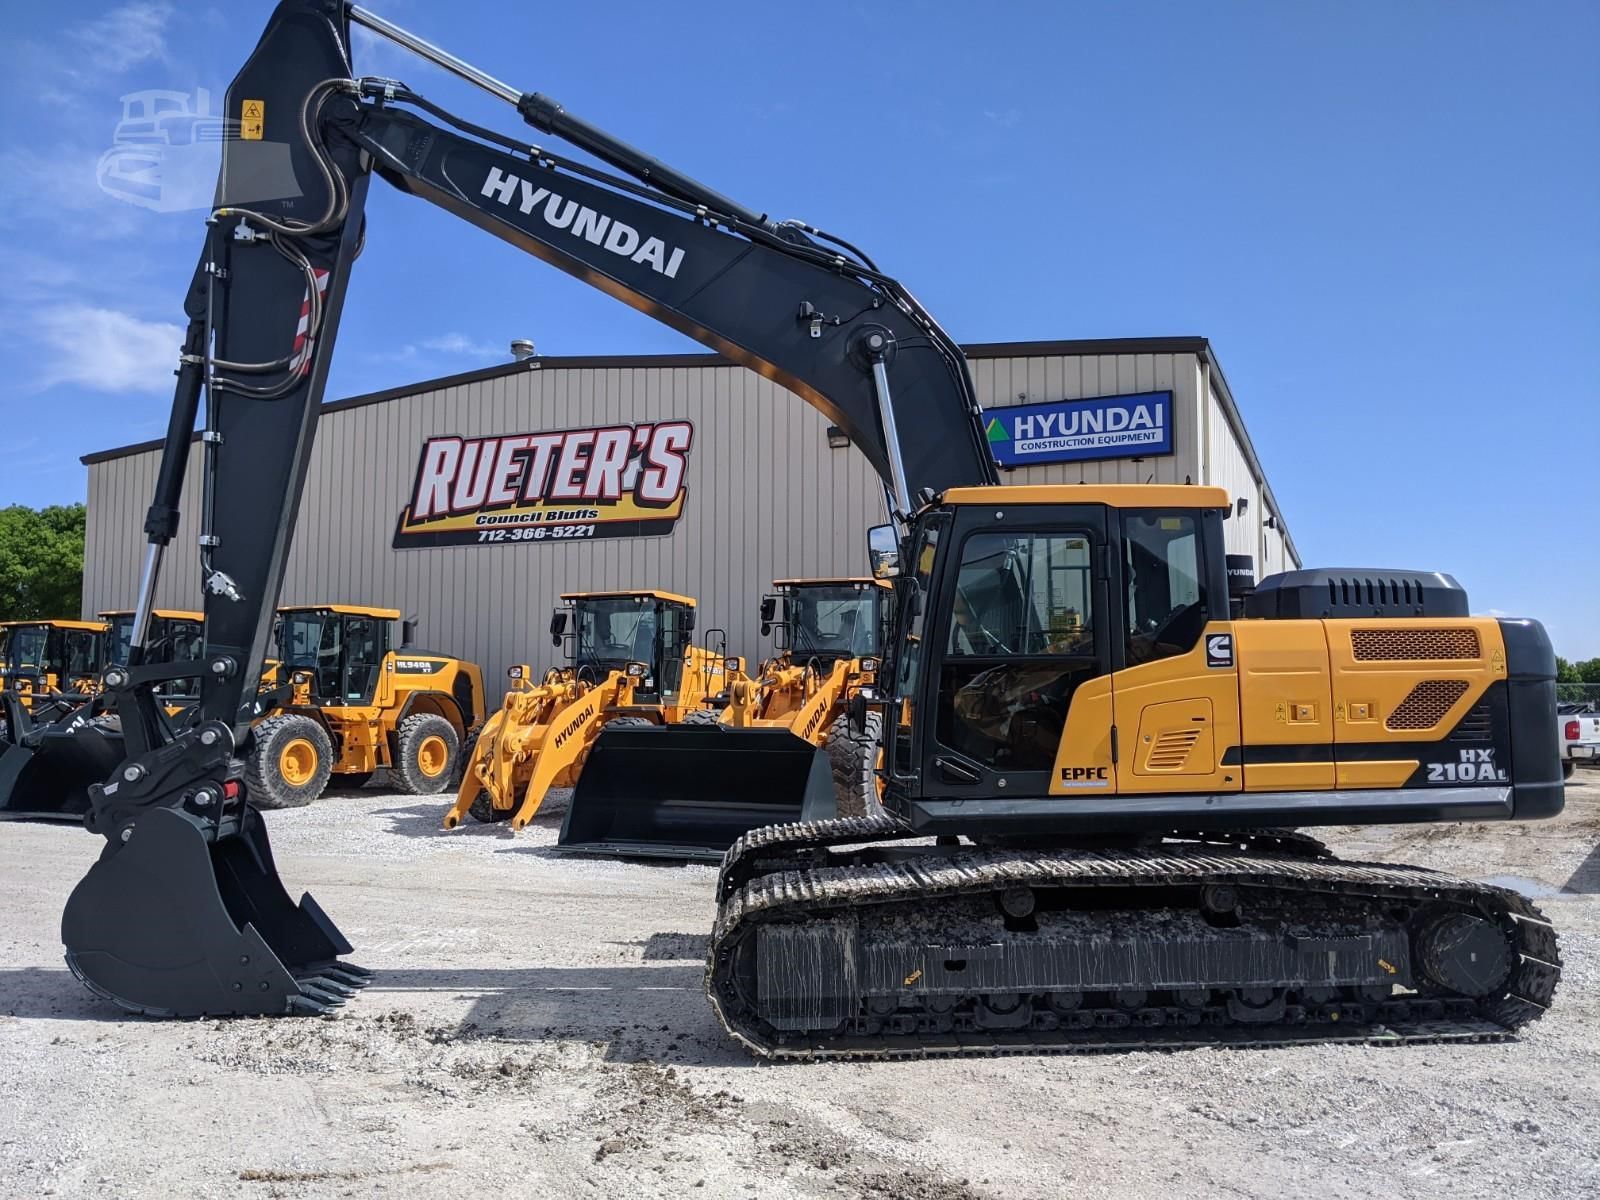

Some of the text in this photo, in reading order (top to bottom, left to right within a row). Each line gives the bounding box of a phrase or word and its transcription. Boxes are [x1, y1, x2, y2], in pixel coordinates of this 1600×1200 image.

[480, 166, 685, 279] HYUNDAI
[1014, 403, 1163, 440] HYUNDAI
[1021, 432, 1156, 451] CONSTRUCTION EQUIPMENT
[413, 422, 693, 519] RUETER'S
[475, 508, 598, 526] Council Bluffs
[477, 524, 596, 542] 712-366-5221
[554, 703, 594, 749] HYUNDAI
[1460, 748, 1492, 762] HX
[1061, 767, 1108, 780] EPFC
